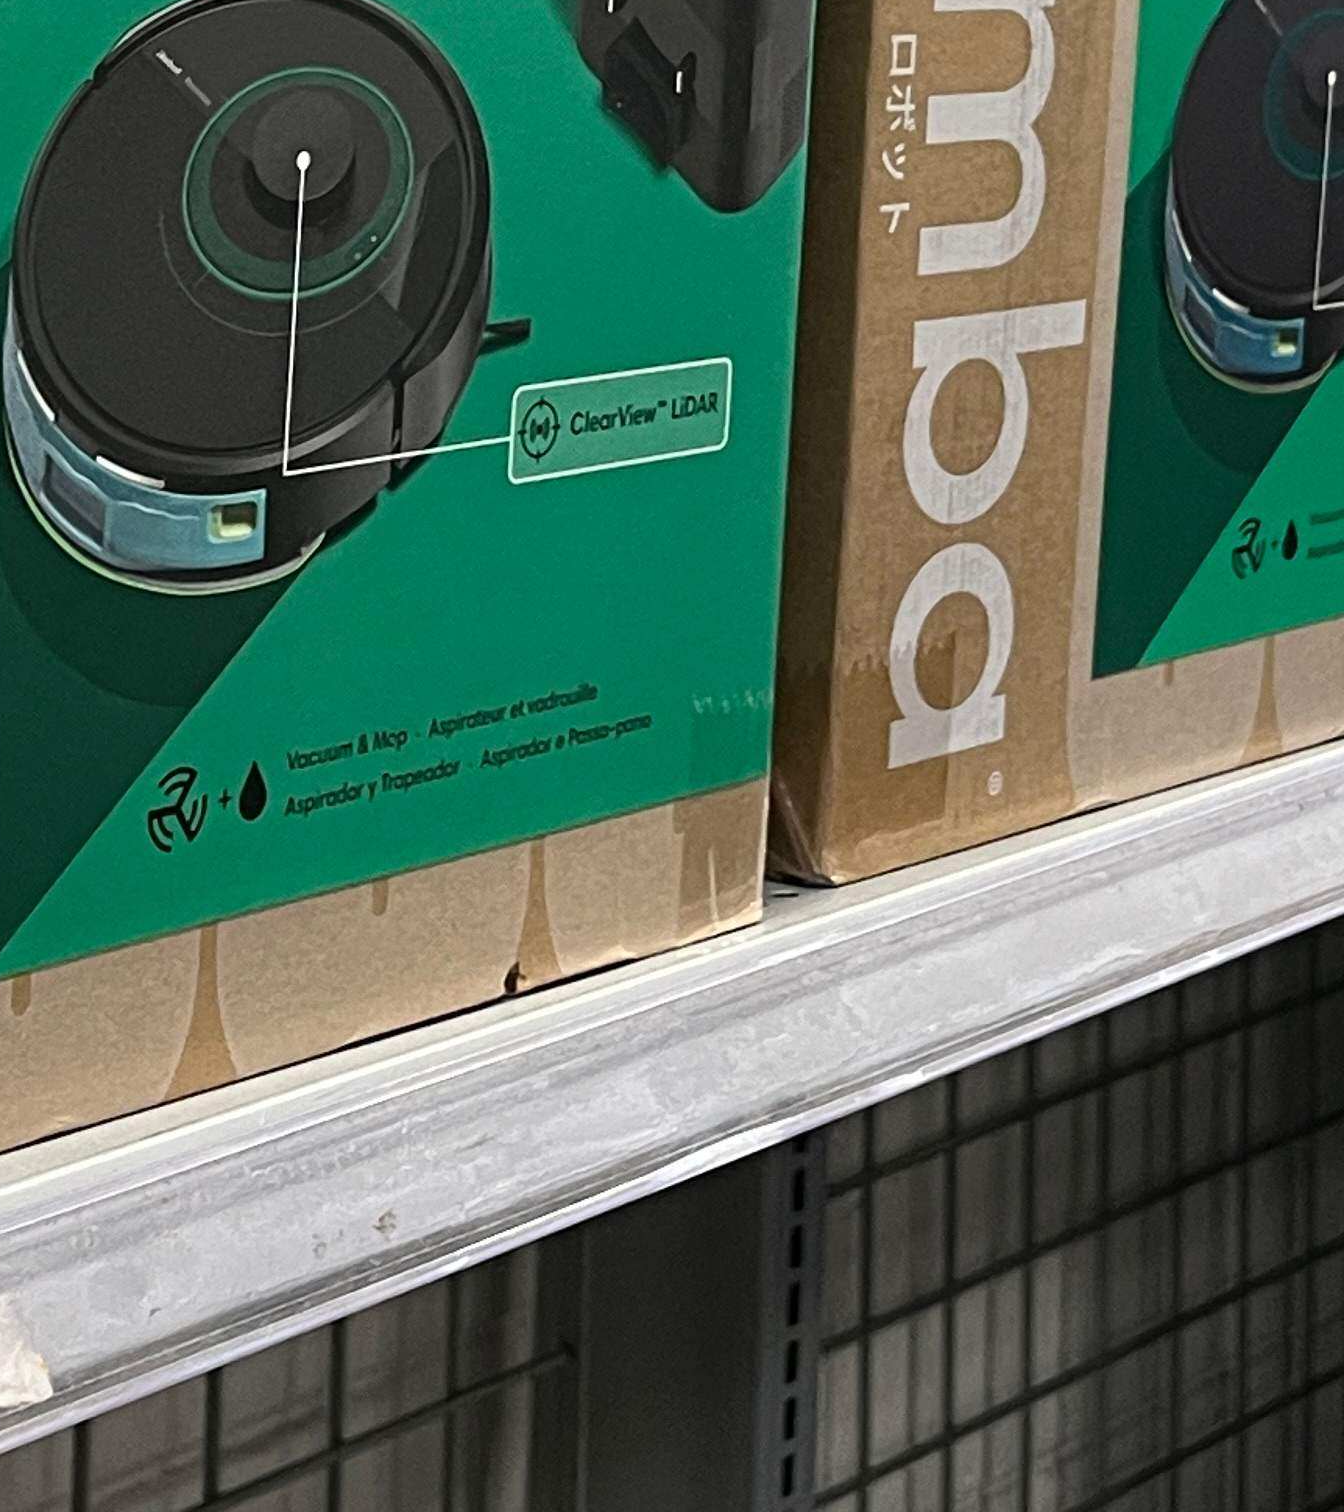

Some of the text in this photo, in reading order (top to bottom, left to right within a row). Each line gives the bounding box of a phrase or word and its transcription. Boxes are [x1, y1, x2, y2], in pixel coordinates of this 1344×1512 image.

[878, 31, 918, 234] ロボット
[671, 391, 720, 421] LiDAR
[286, 741, 354, 771] Vacuum
[372, 727, 410, 753] Mop
[427, 704, 507, 740] Aspirateur
[509, 699, 526, 720] et
[284, 781, 365, 818] Aspirador
[366, 779, 378, 804] y
[381, 759, 463, 794] Trapeador
[480, 736, 552, 769] Aspirador
